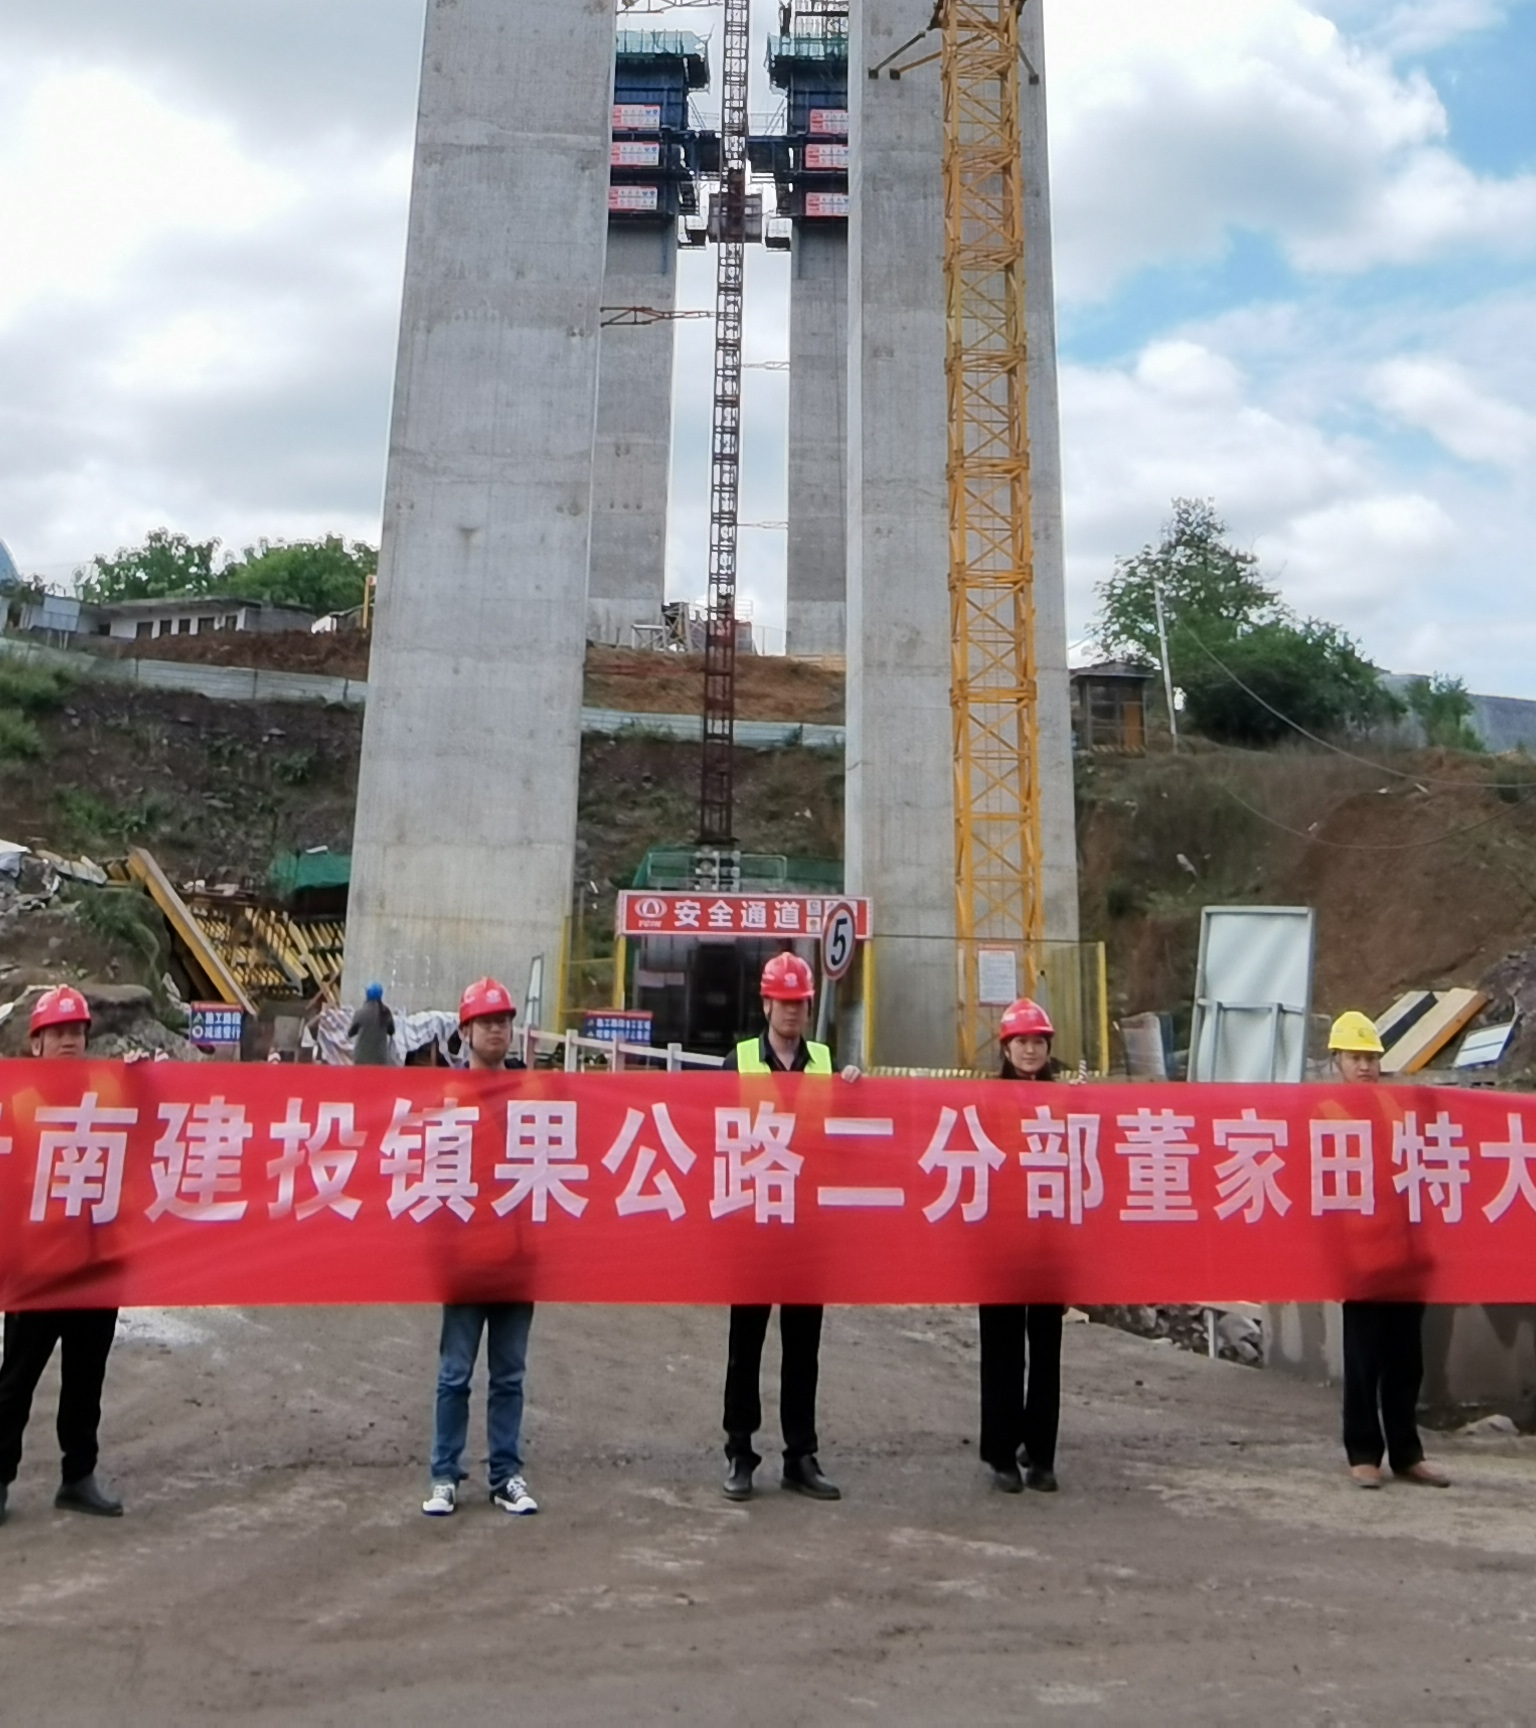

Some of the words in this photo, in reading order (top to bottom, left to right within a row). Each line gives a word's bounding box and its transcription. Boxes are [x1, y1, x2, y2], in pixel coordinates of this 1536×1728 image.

[674, 899, 800, 929] 安全通道
[831, 918, 848, 966] 5
